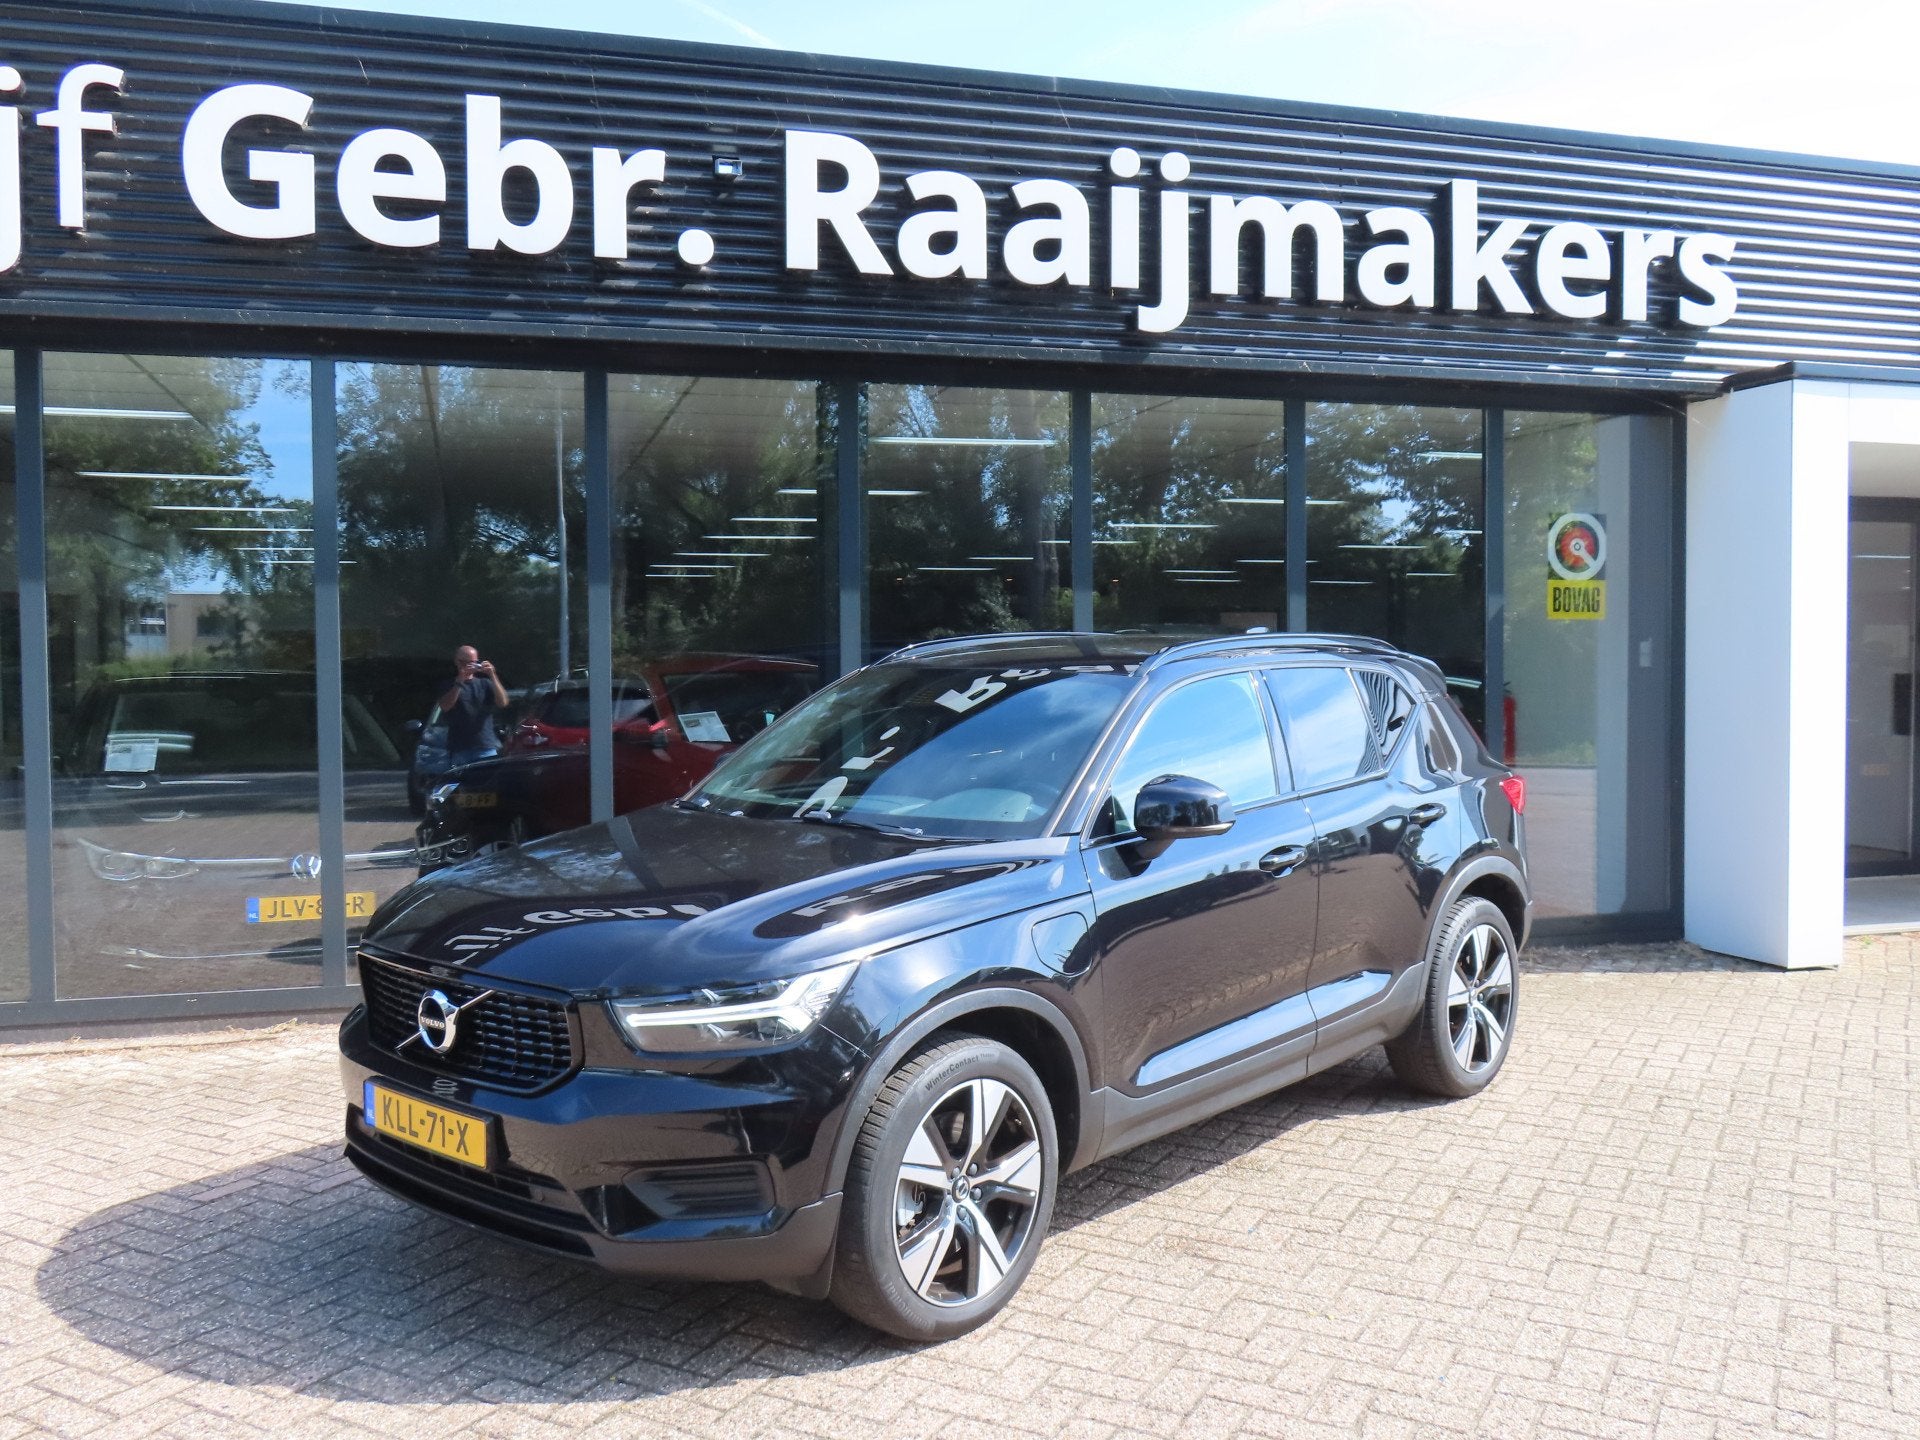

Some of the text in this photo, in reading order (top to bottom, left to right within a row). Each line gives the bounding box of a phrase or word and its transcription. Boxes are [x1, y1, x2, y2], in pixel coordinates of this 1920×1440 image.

[183, 84, 715, 265] Gebr.
[785, 130, 1738, 332] Raaijmakers
[1552, 587, 1601, 613] BOVAG
[420, 1016, 445, 1029] VOLVO
[924, 1054, 979, 1091] WinterContact
[383, 1094, 470, 1156] KLL-71-X
